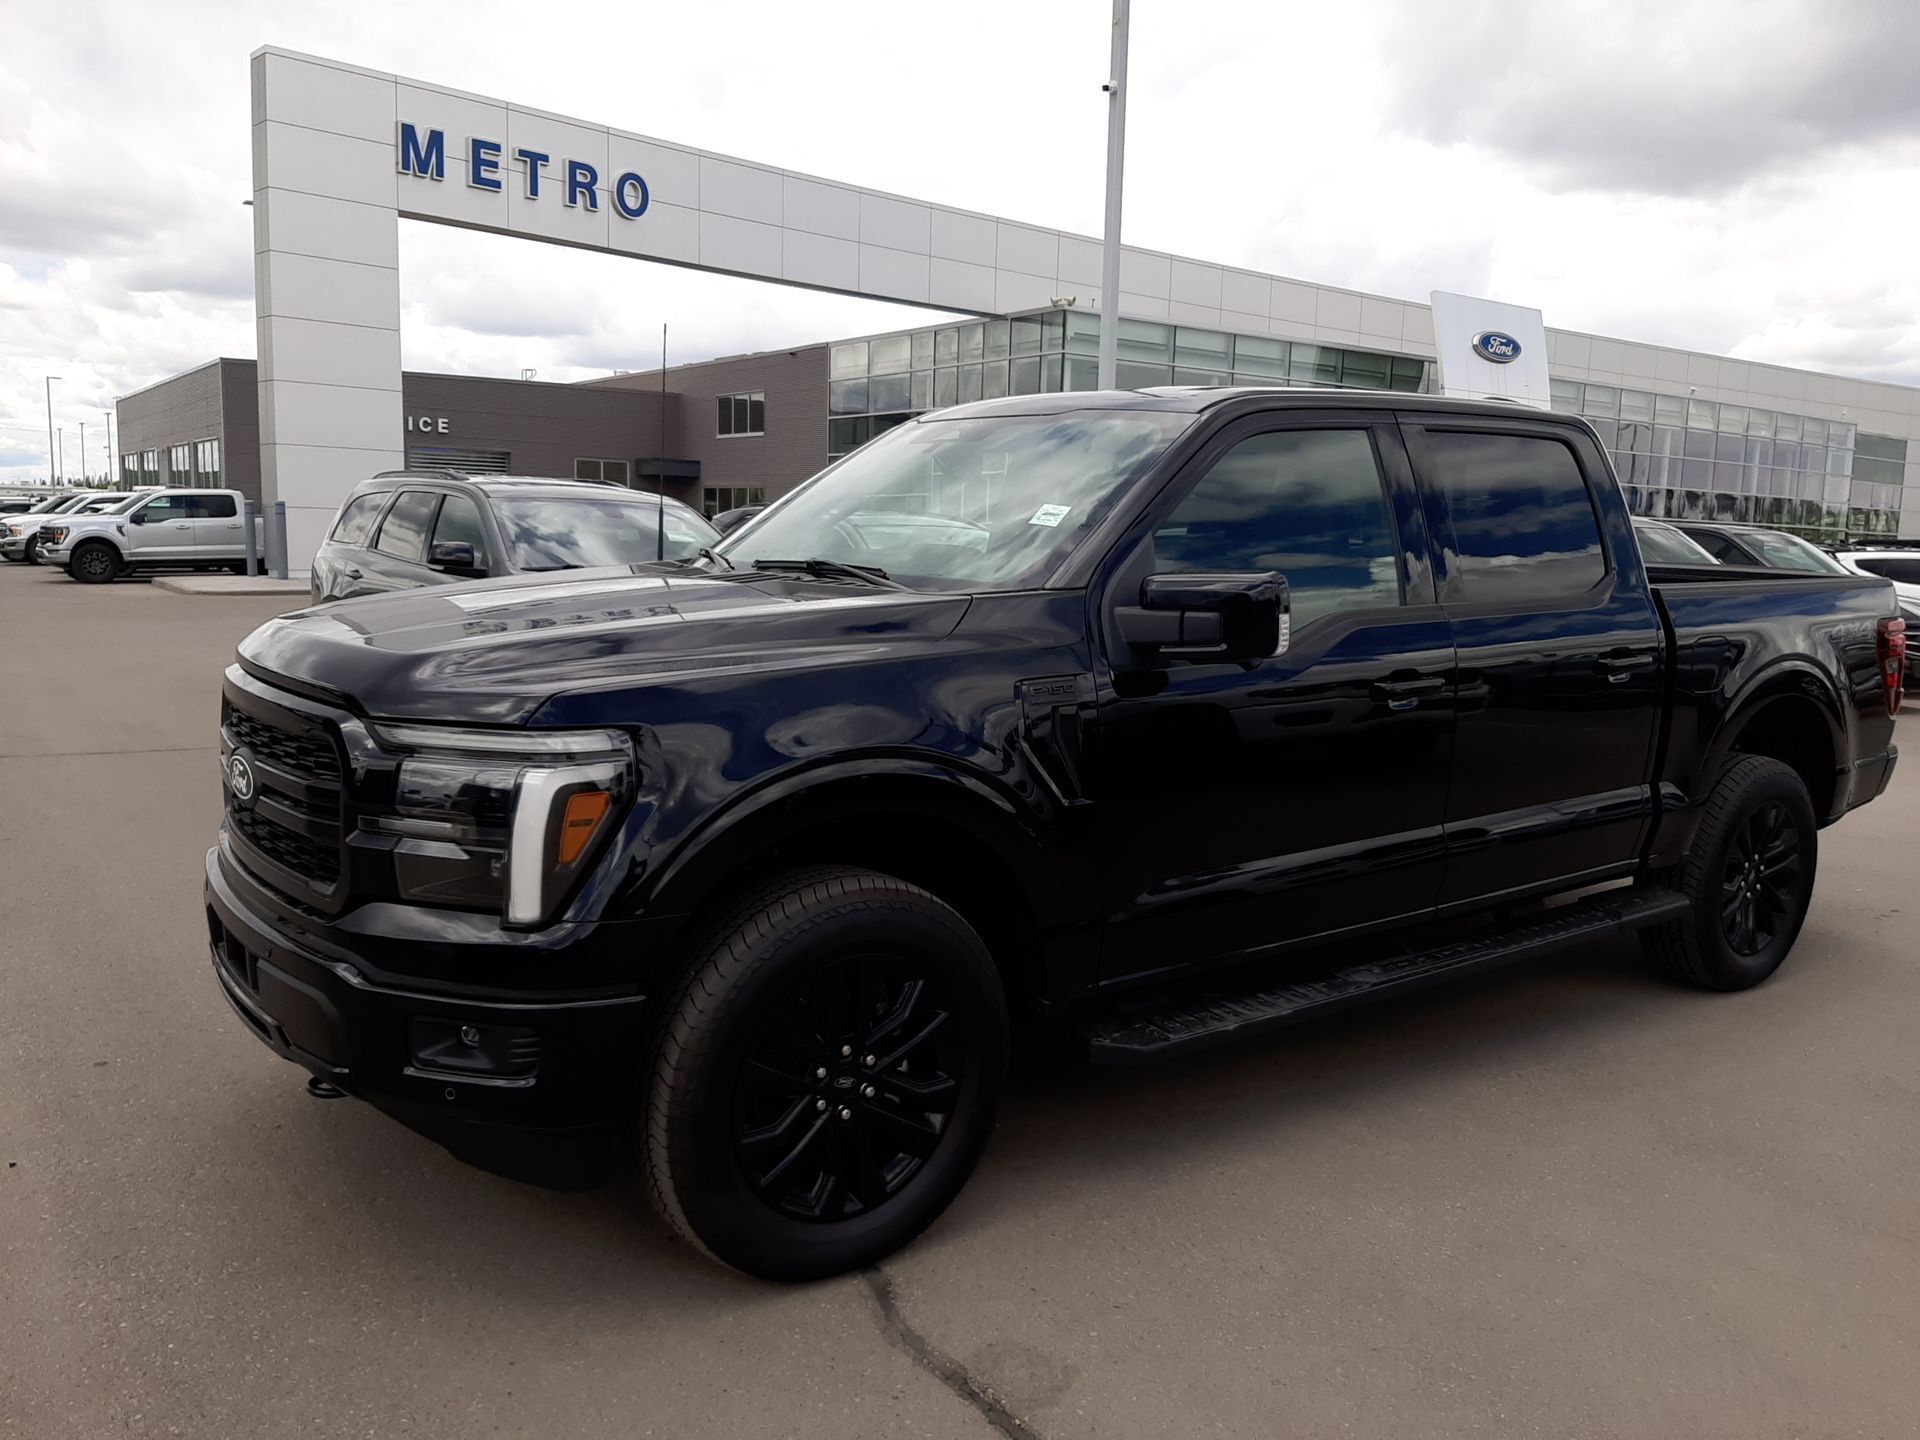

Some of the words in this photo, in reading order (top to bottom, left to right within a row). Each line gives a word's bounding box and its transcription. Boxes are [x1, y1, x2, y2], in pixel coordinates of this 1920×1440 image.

[398, 120, 650, 220] METRO
[1488, 336, 1513, 356] Ford
[232, 760, 248, 794] Ford
